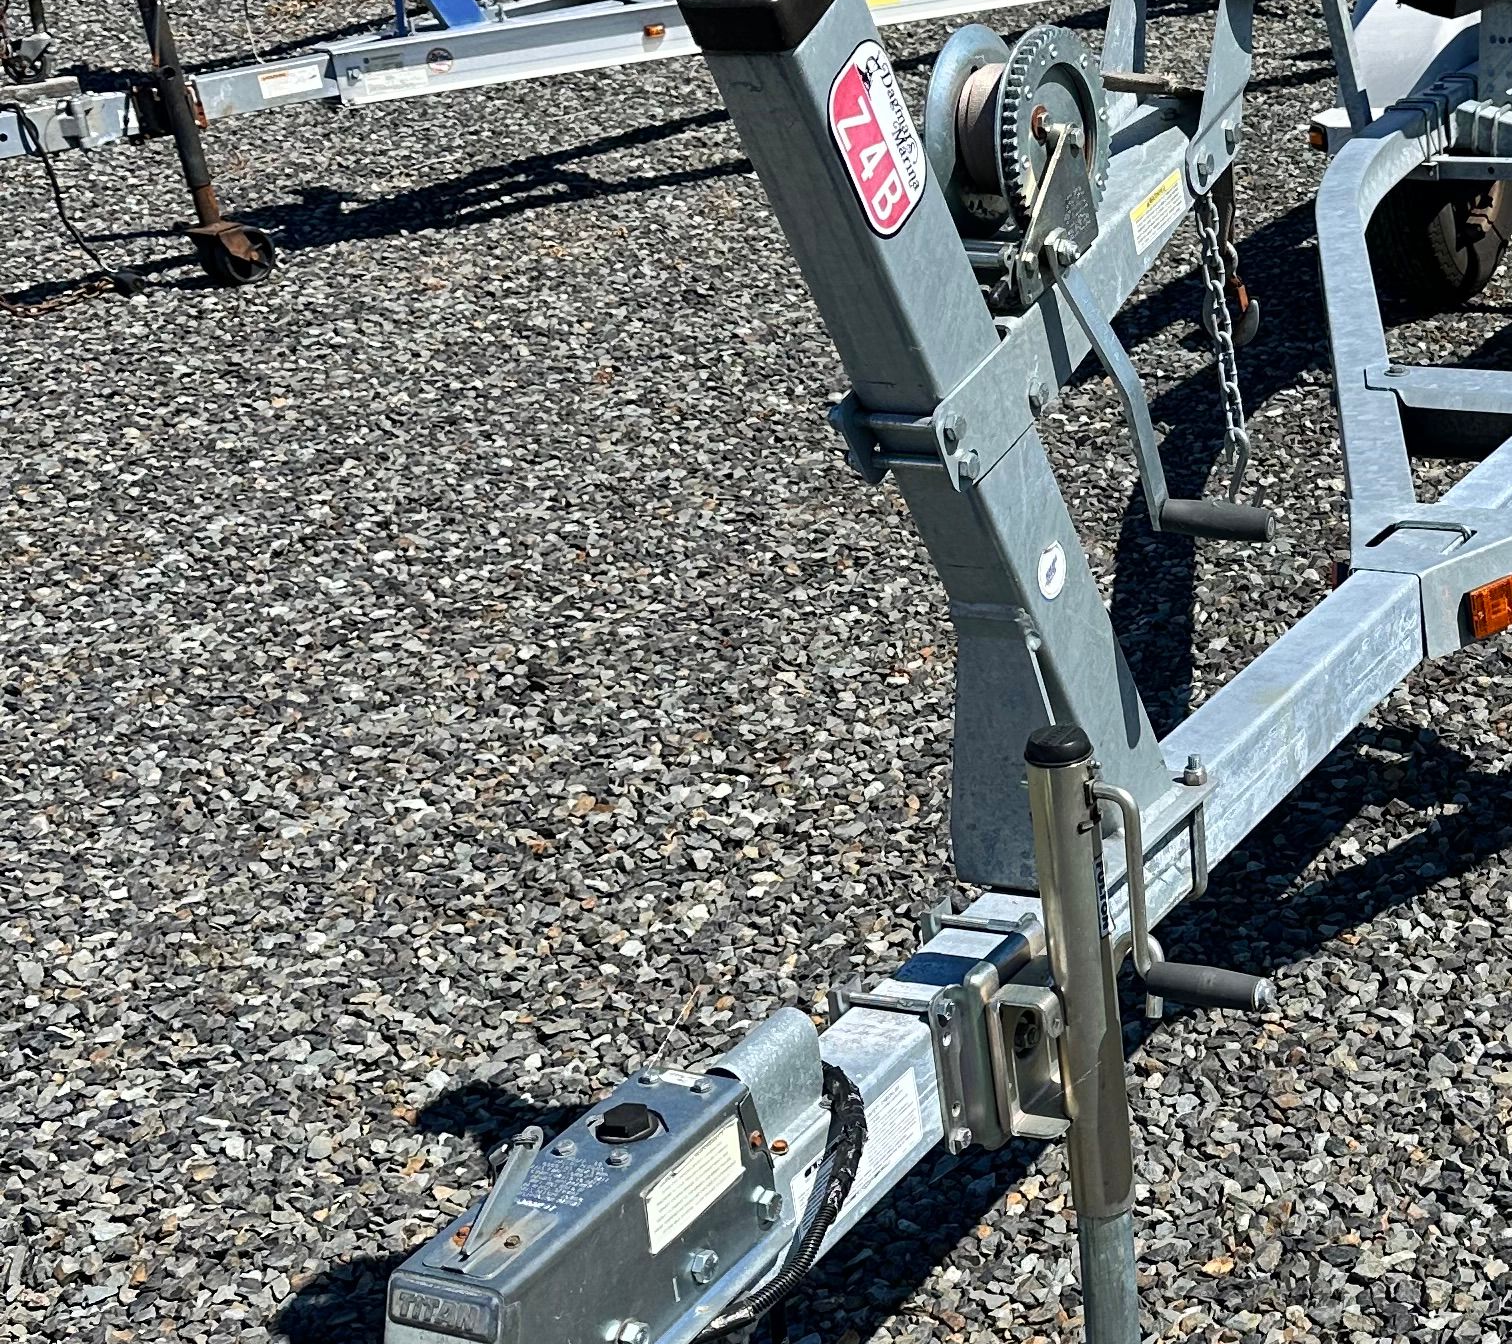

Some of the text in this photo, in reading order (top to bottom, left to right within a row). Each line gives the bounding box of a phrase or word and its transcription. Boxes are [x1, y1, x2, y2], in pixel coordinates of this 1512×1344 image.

[837, 94, 904, 222] Z4B
[892, 121, 921, 192] Marina
[398, 1290, 479, 1333] TITAN
